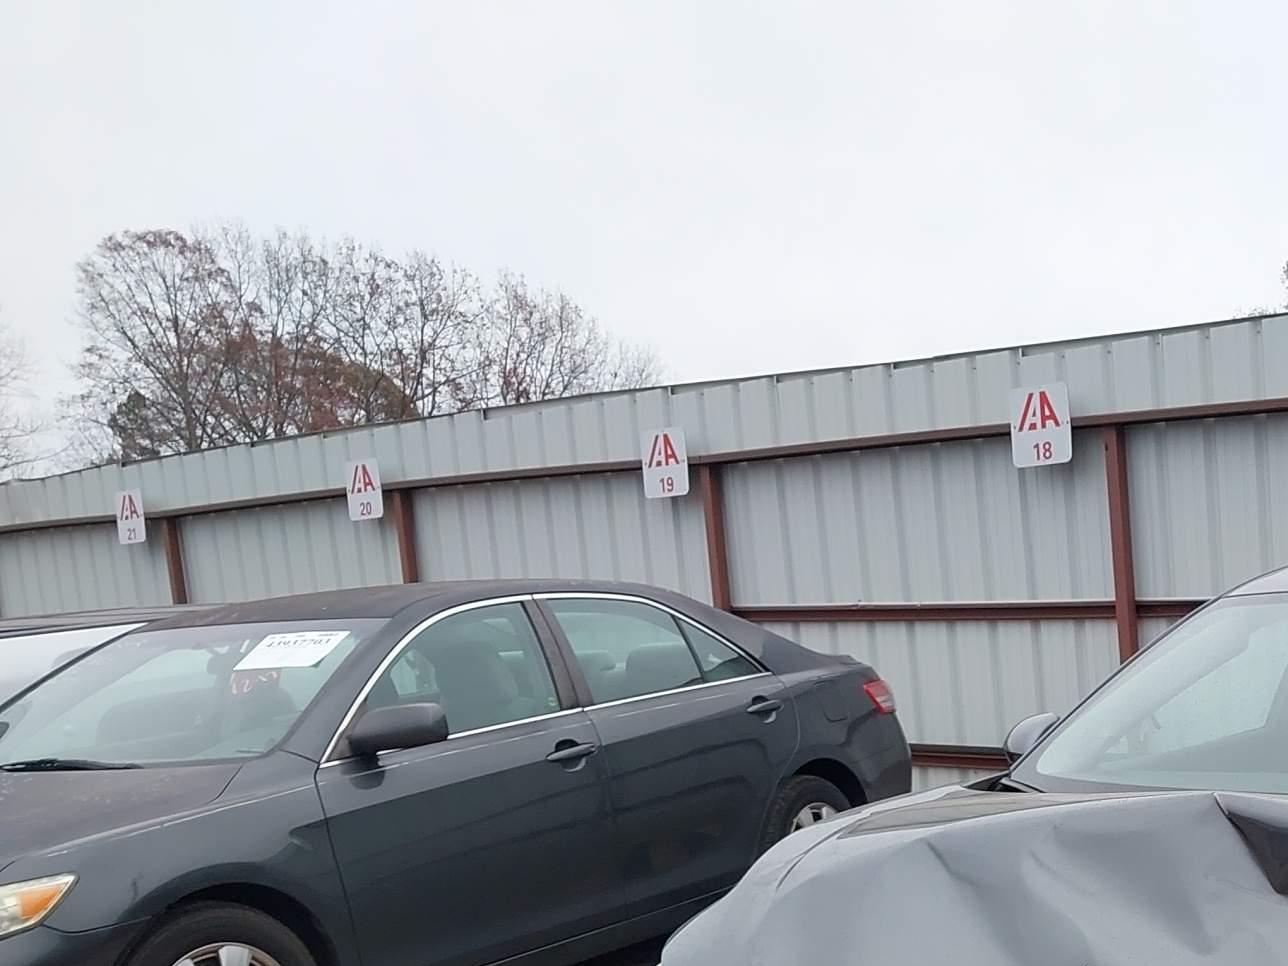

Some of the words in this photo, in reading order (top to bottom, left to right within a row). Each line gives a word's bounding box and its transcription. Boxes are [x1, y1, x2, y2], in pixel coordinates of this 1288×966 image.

[1033, 441, 1053, 461] 18
[659, 476, 674, 493] 19
[360, 501, 372, 516] 20
[127, 527, 137, 541] 21
